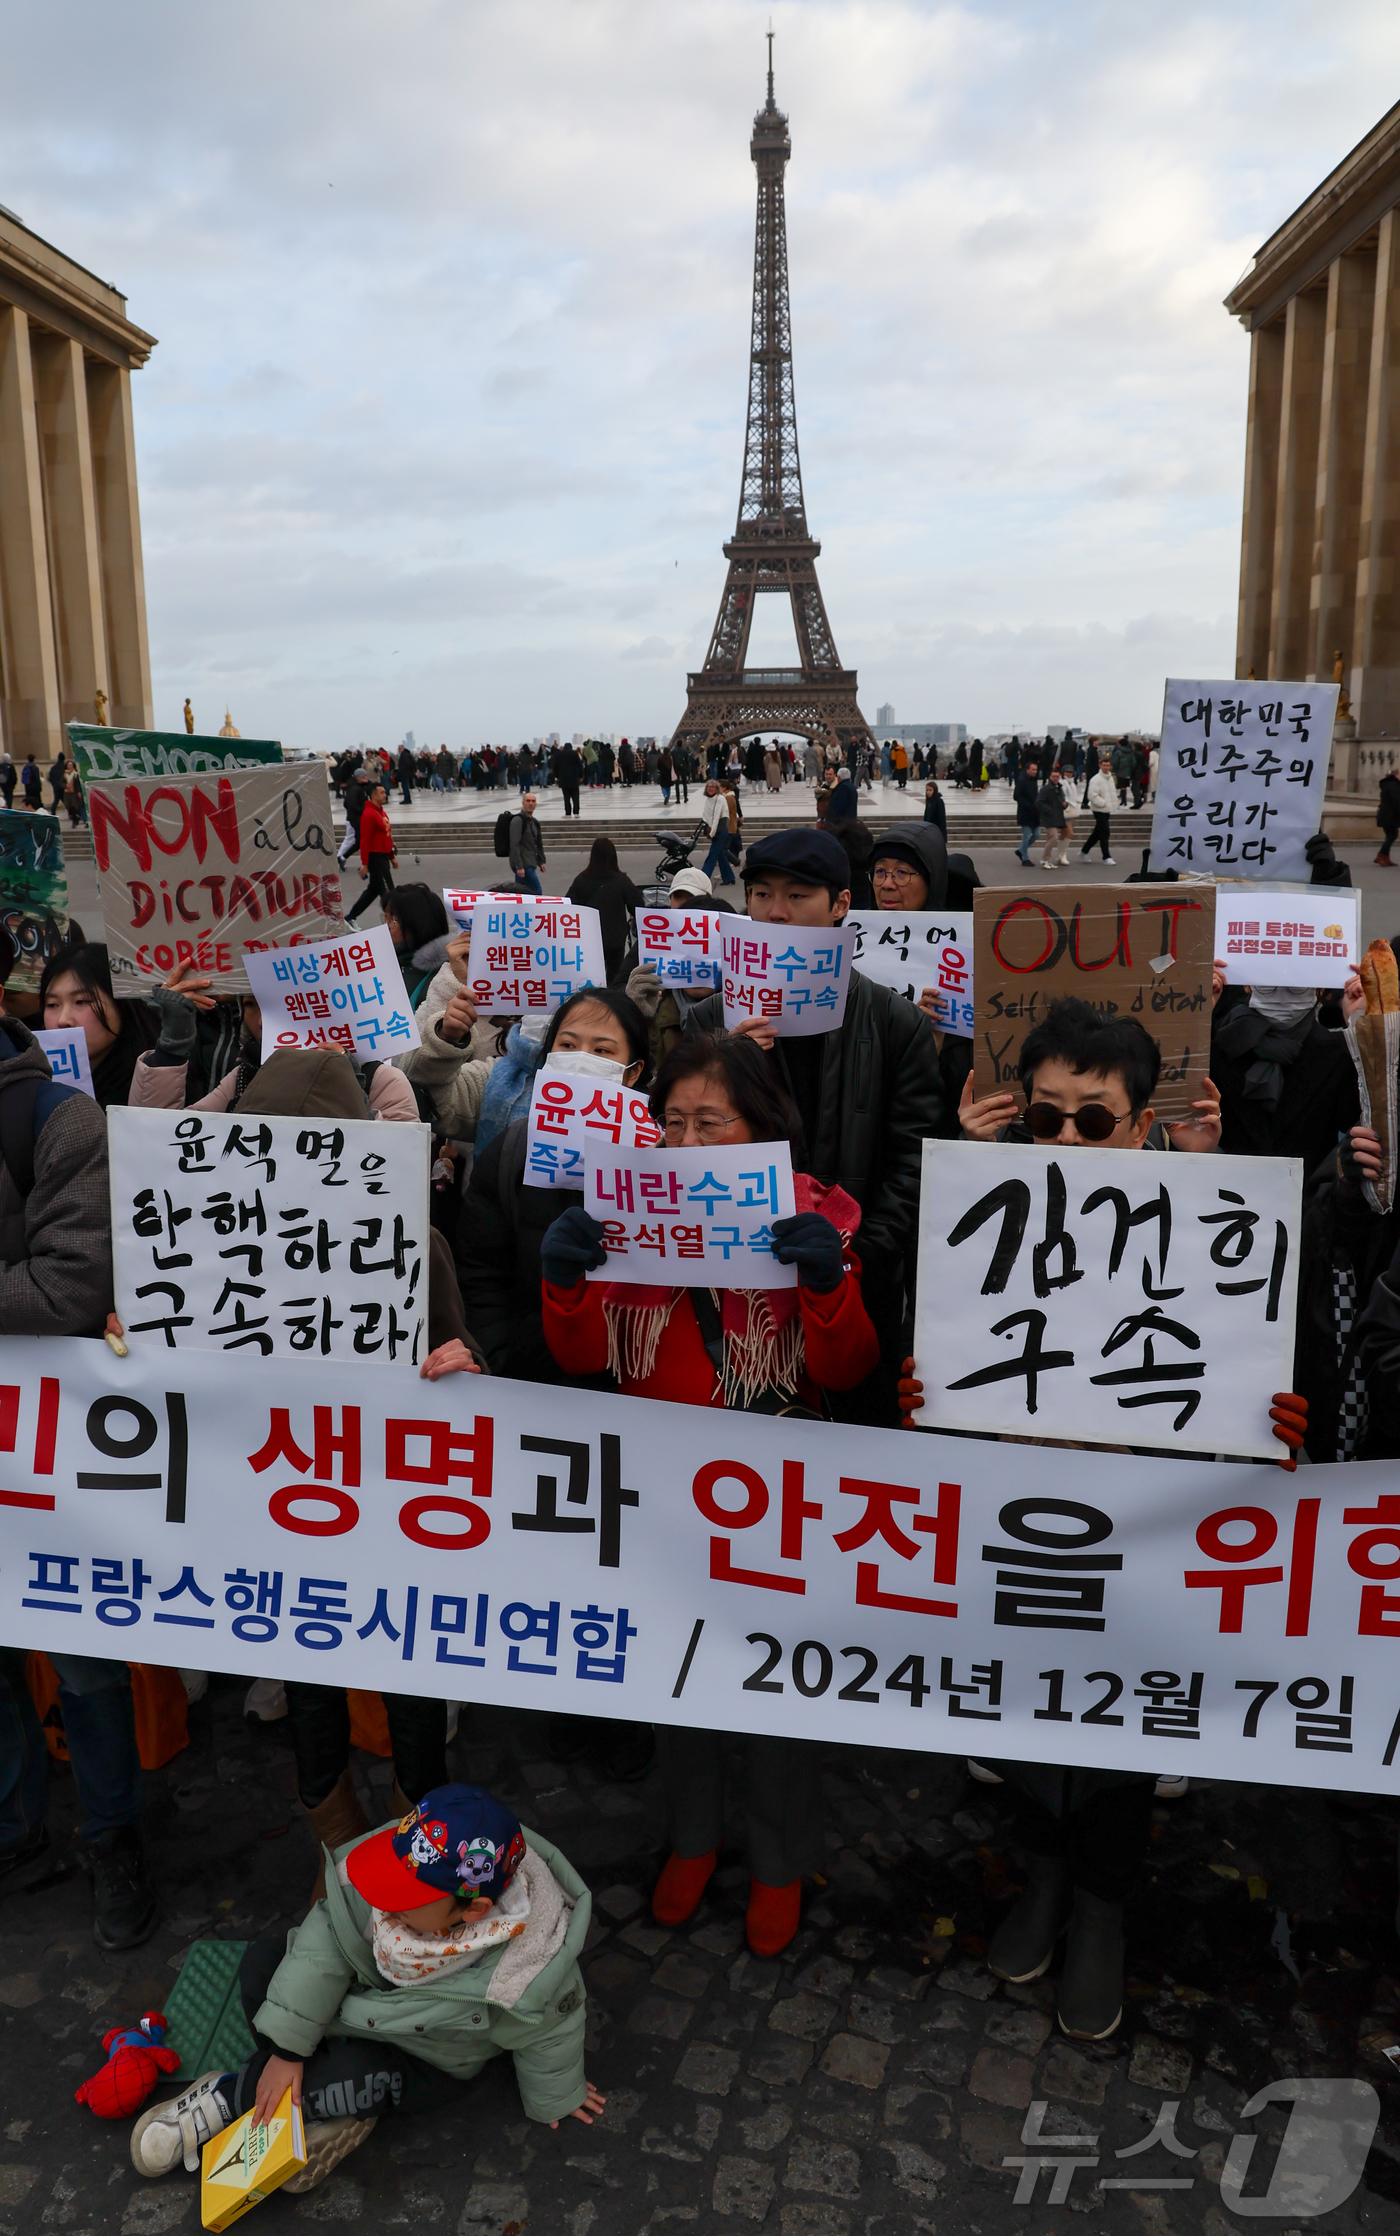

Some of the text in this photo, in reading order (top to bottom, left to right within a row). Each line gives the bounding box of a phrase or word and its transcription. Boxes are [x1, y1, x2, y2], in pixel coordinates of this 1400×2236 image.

[1180, 698, 1312, 742] 대한민국
[1177, 742, 1314, 787] 민주주의
[89, 777, 241, 873] NON
[253, 818, 280, 851] à
[282, 789, 334, 856] la
[1167, 794, 1278, 830] 우리가
[1167, 834, 1277, 866] 지킨다
[487, 911, 581, 939] 비상계엄
[641, 914, 720, 954] 윤석
[990, 896, 1202, 974] OUT
[1227, 921, 1315, 938] 피를 토하는
[135, 928, 234, 974] CORÉE
[272, 940, 376, 986] 비상계엄
[486, 945, 584, 971] 왠말이냐
[723, 936, 843, 982] 내란수괴
[1226, 939, 1348, 958] 심정으로 말한다
[284, 976, 385, 1022] 왠말이냐
[472, 979, 597, 1007] 윤석열구
[724, 978, 839, 1017] 윤석열구속
[596, 1165, 779, 1216] 내란수괴
[602, 1219, 779, 1260] 윤석열구속
[946, 1161, 1289, 1322] 김건희
[945, 1305, 1206, 1432] 구속
[247, 1405, 639, 1568] 생명과
[692, 1458, 1124, 1632] 안전을
[21, 1551, 638, 1684] 프랑스행동시민연합
[742, 1631, 1003, 1722] 2024년
[1033, 1668, 1205, 1740] 12월
[1233, 1675, 1355, 1754] 7일
[248, 2126, 258, 2168] PARIS
